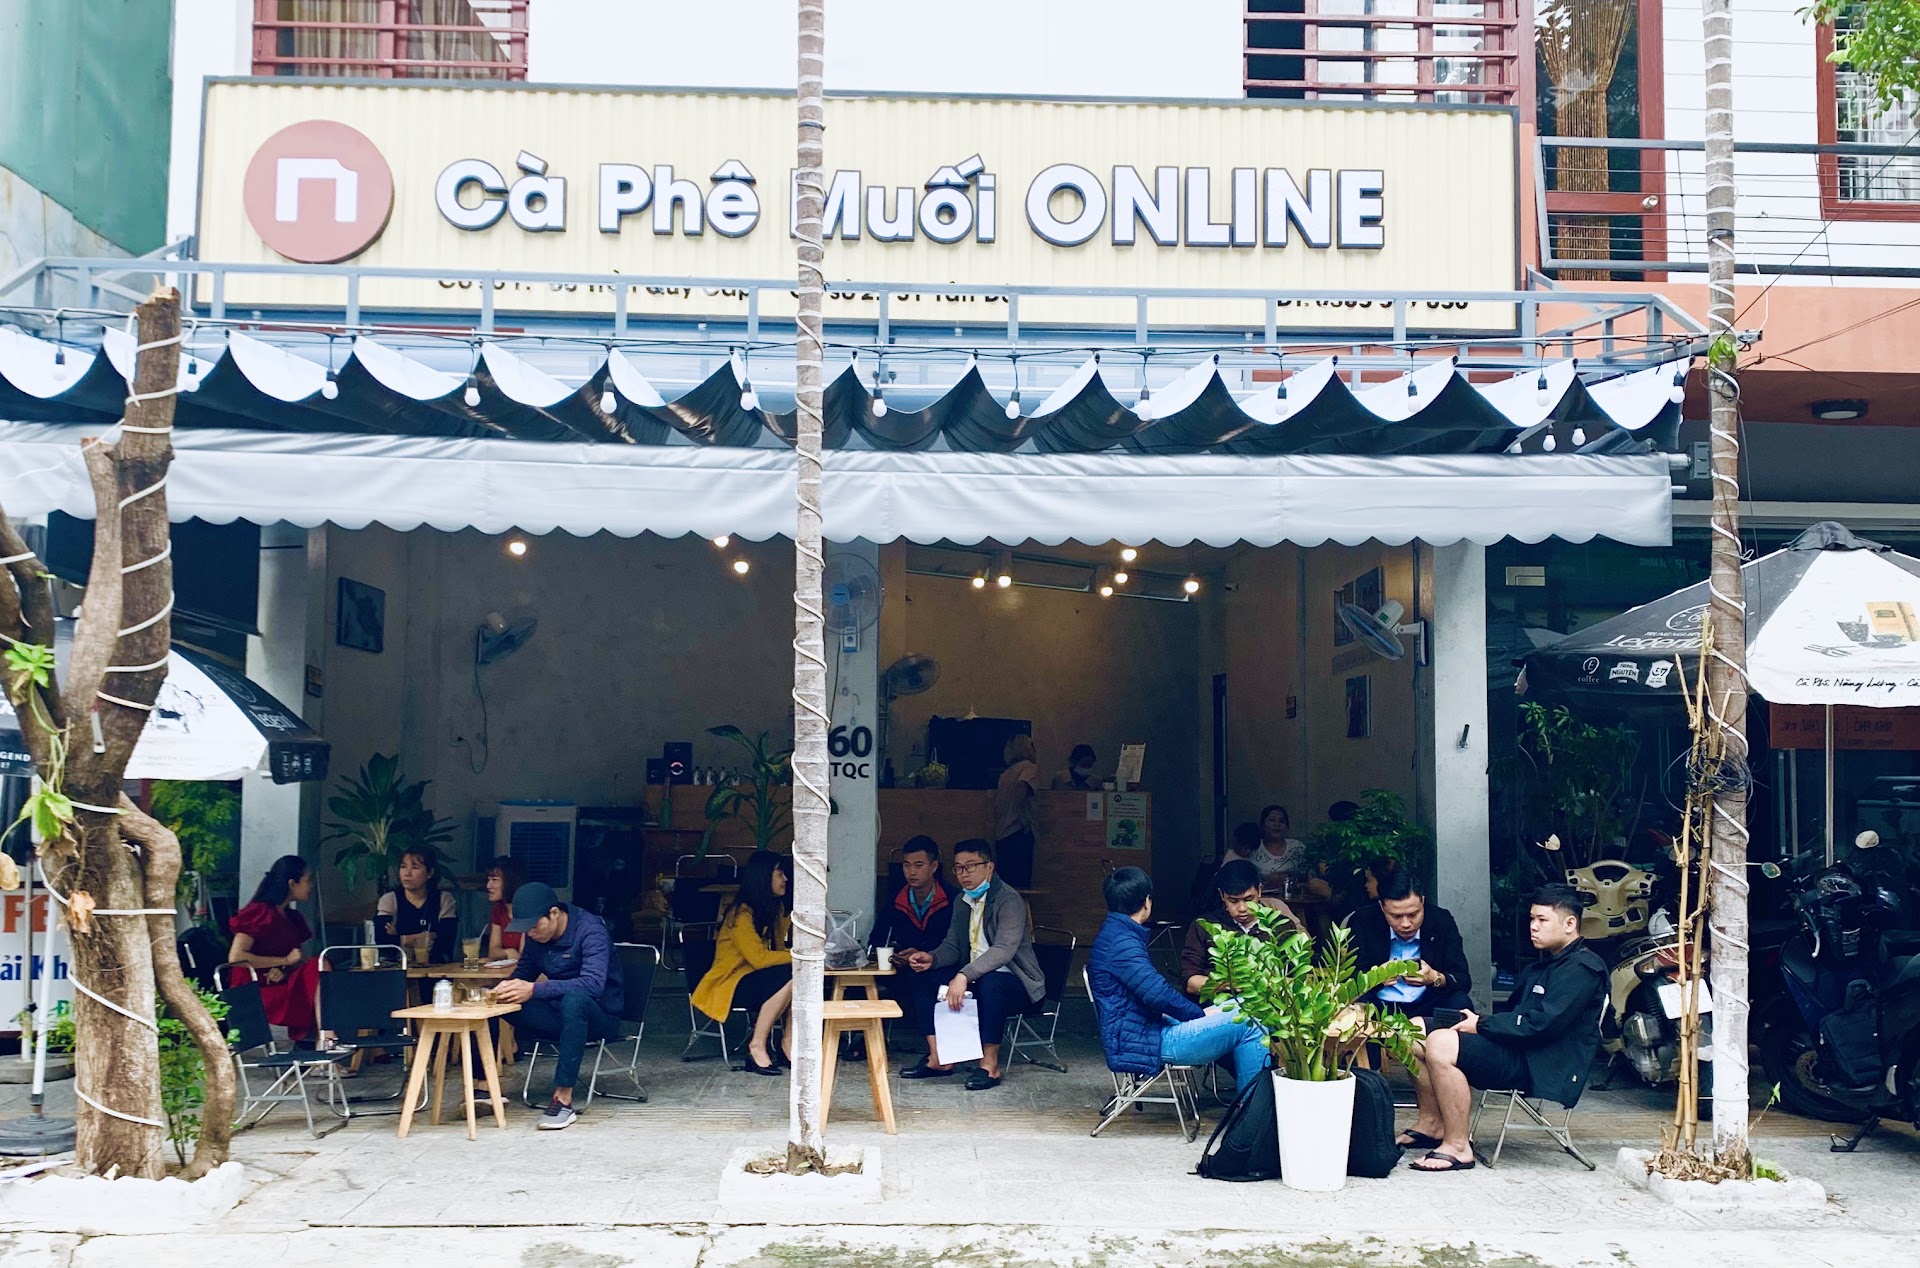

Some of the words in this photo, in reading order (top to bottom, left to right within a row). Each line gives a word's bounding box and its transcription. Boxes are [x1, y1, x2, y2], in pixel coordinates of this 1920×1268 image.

[435, 150, 567, 232] Cà
[599, 159, 760, 238] Phê
[1025, 164, 1385, 249] ONLINE
[1578, 675, 1599, 683] coffee
[828, 726, 873, 757] 60
[831, 762, 870, 779] TQC
